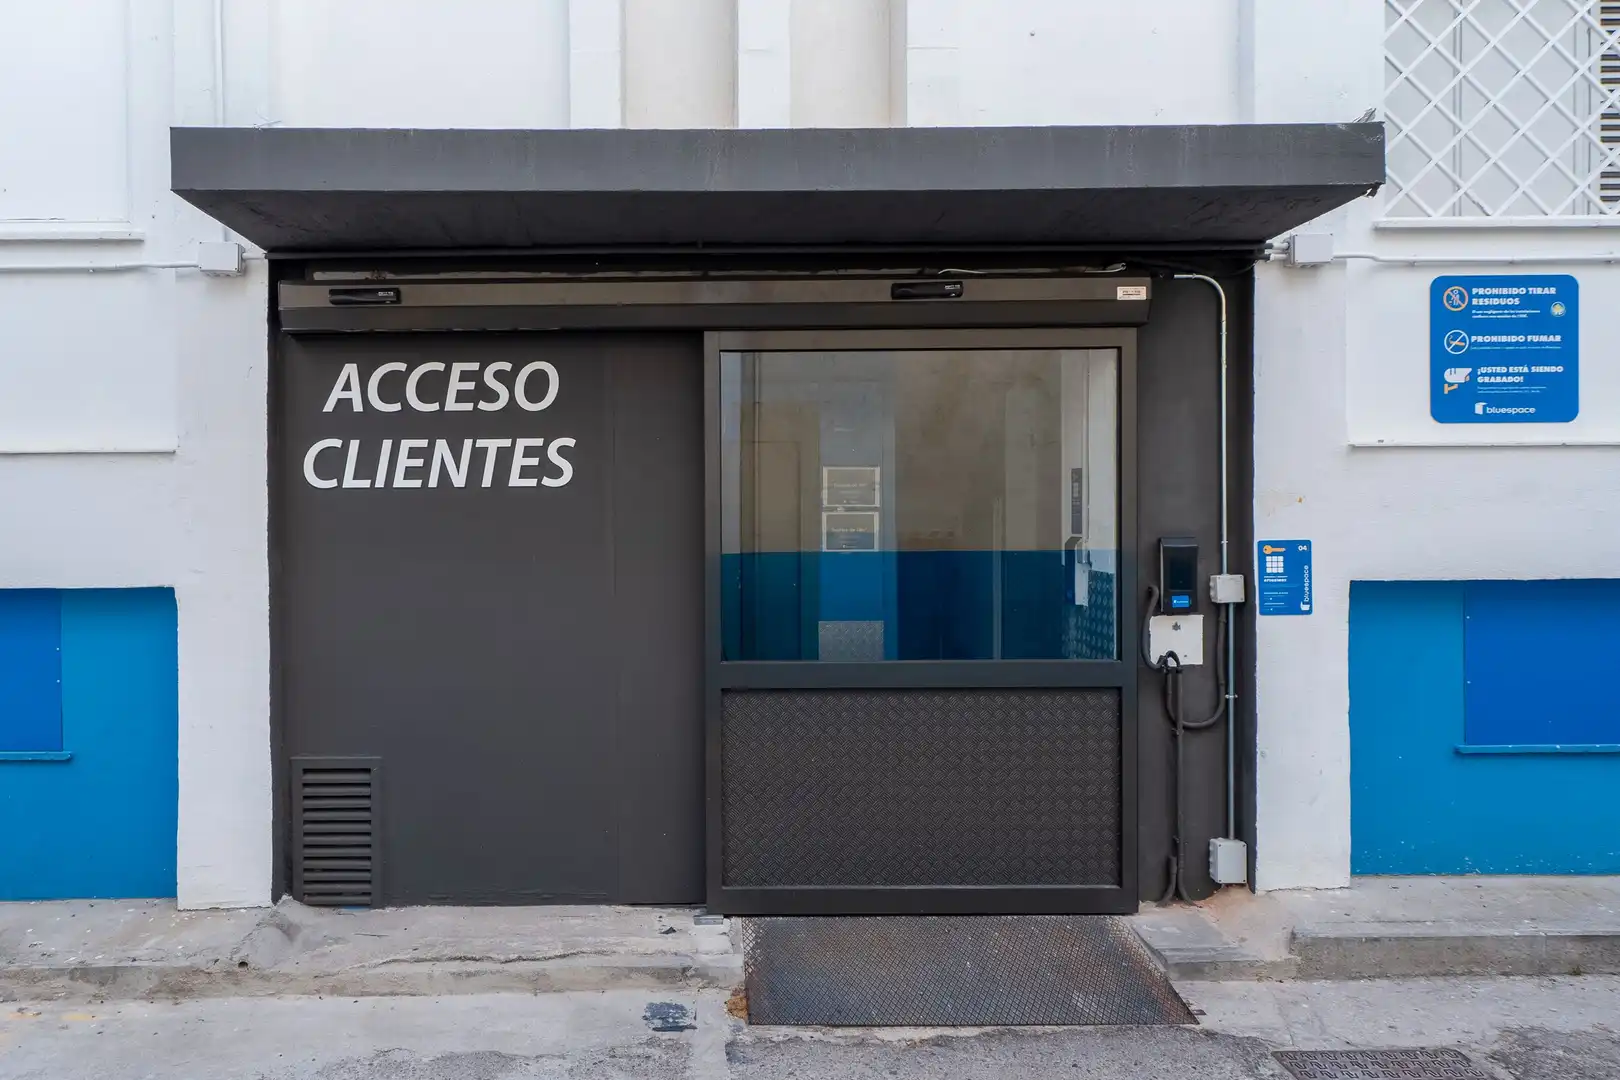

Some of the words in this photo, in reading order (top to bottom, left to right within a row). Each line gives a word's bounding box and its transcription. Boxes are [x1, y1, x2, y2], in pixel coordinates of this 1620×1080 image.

[1472, 287, 1526, 295] PROHIBIDO
[1528, 287, 1556, 295] TIRAR
[1477, 366, 1507, 375] ¡USTED
[1509, 364, 1529, 373] ESTÁ
[322, 361, 560, 412] ACCESO
[1486, 406, 1536, 414] bluespace
[303, 437, 577, 489] CLIENTES
